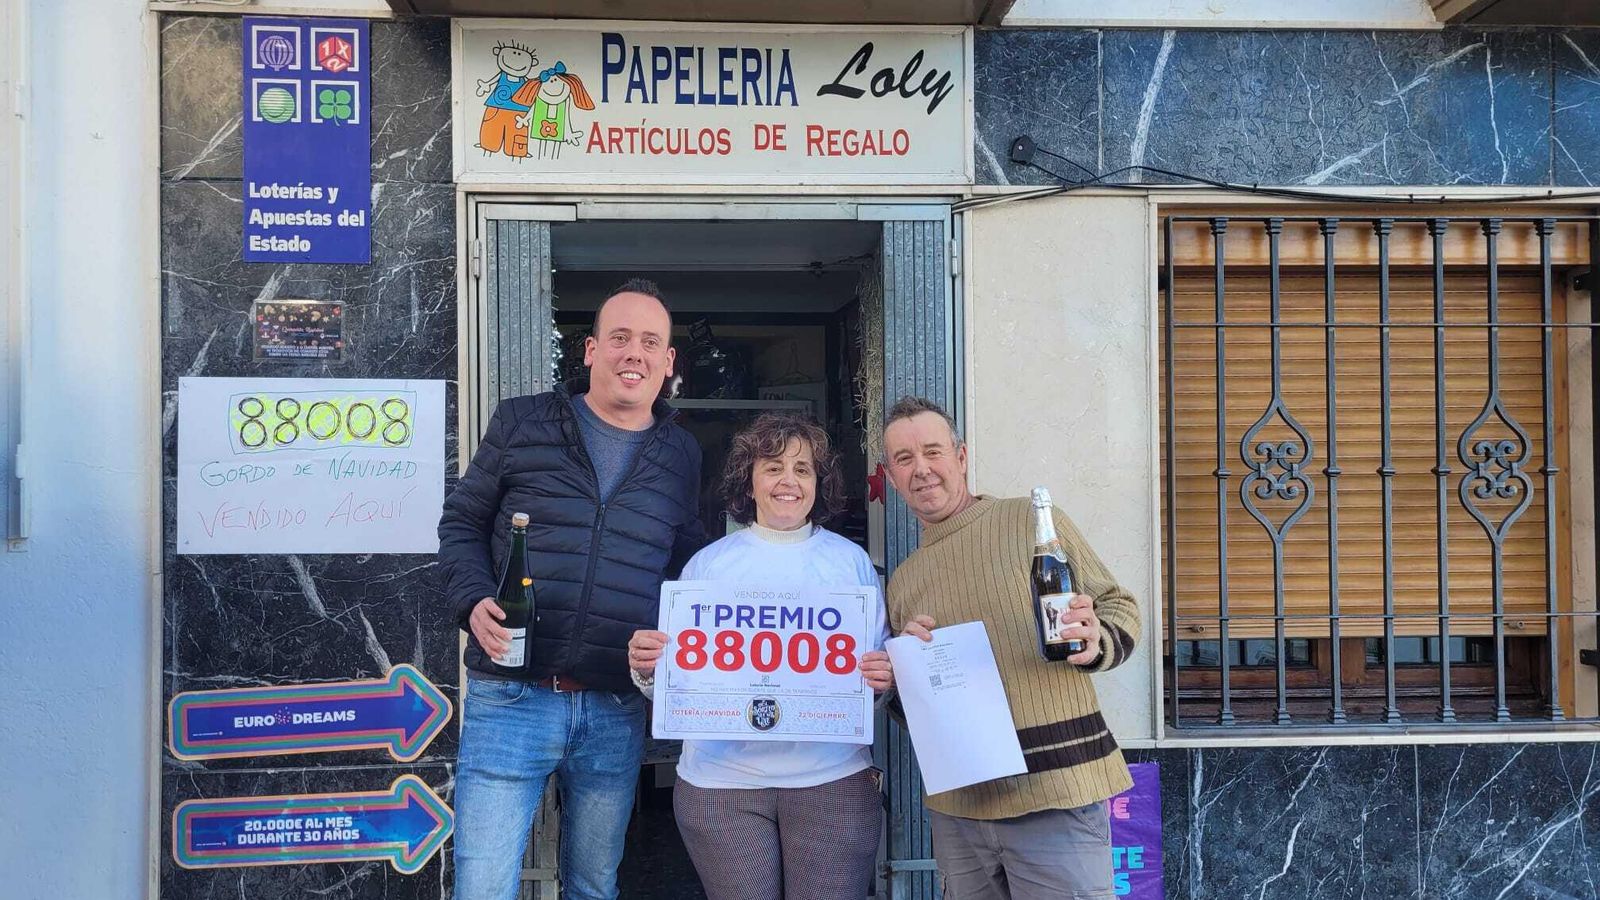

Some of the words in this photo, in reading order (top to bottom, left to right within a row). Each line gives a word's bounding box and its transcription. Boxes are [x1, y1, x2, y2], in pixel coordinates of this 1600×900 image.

[601, 32, 799, 107] PAPELERIA
[817, 41, 955, 115] Loly
[585, 117, 732, 156] ARTÍCULOS
[754, 123, 787, 151] DE
[806, 125, 910, 157] REGALO
[249, 182, 323, 200] Loterías
[327, 186, 339, 204] y
[249, 208, 332, 229] Apuestas
[338, 209, 365, 227] del
[249, 235, 311, 253] Estado
[238, 397, 410, 449] 88008
[200, 460, 277, 487] GORDO
[295, 463, 313, 477] DE
[328, 450, 418, 482] NAVIDAD
[198, 500, 307, 538] VENDIDO
[714, 603, 842, 631] PREMIO
[675, 628, 857, 676] 88008
[234, 714, 276, 728] EURO
[292, 710, 356, 725] DREAMS
[237, 832, 302, 845] DURANTE
[303, 831, 320, 842] 30
[323, 828, 360, 841] AÑOS
[305, 818, 324, 829] AL
[325, 816, 353, 828] MES
